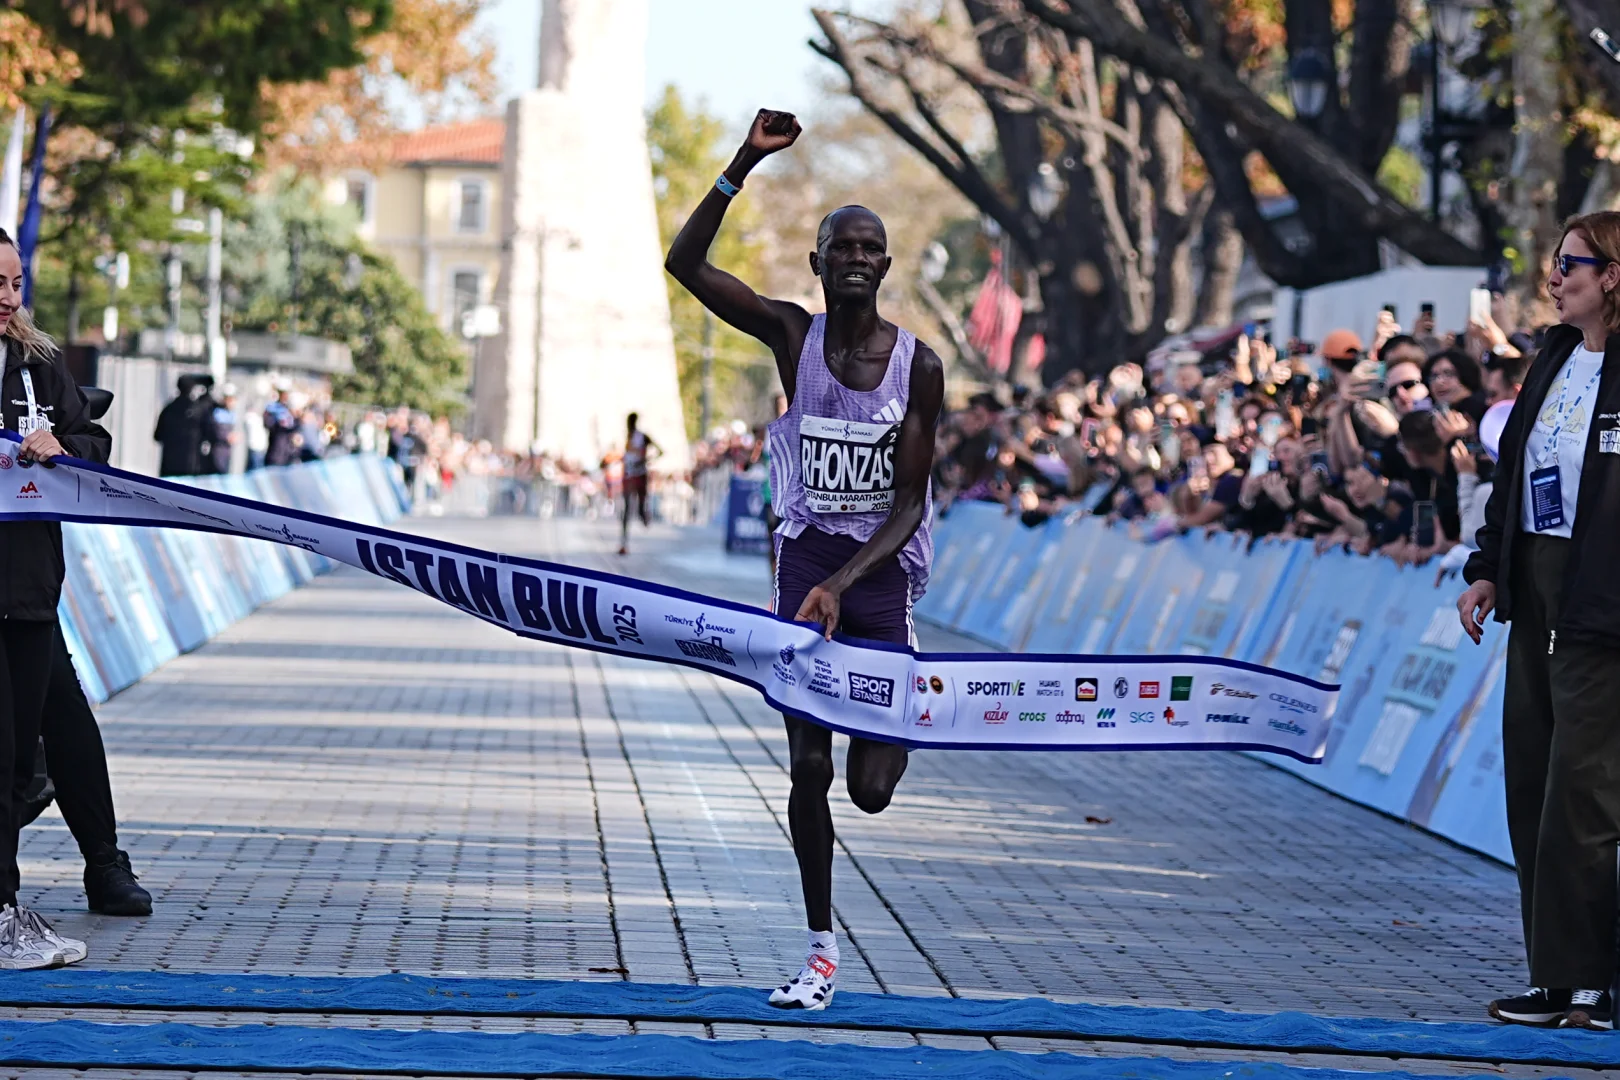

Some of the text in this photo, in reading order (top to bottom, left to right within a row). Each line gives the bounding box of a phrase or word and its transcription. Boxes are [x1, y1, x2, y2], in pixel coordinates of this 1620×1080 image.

[888, 432, 897, 443] 2
[802, 439, 894, 490] RHONZAS
[806, 490, 888, 502] STANBUL MARATHON
[871, 501, 890, 511] 2025
[356, 538, 618, 645] ISTANBUL
[613, 603, 645, 645] 2025
[664, 614, 694, 627] TÜRKİYE
[705, 623, 736, 635] BANKASI
[850, 674, 890, 696] SPOR
[967, 679, 1026, 697] SPORTIVE
[983, 710, 1010, 721] KIZILAY
[1018, 711, 1046, 722] crocs
[1130, 711, 1156, 724] SKG
